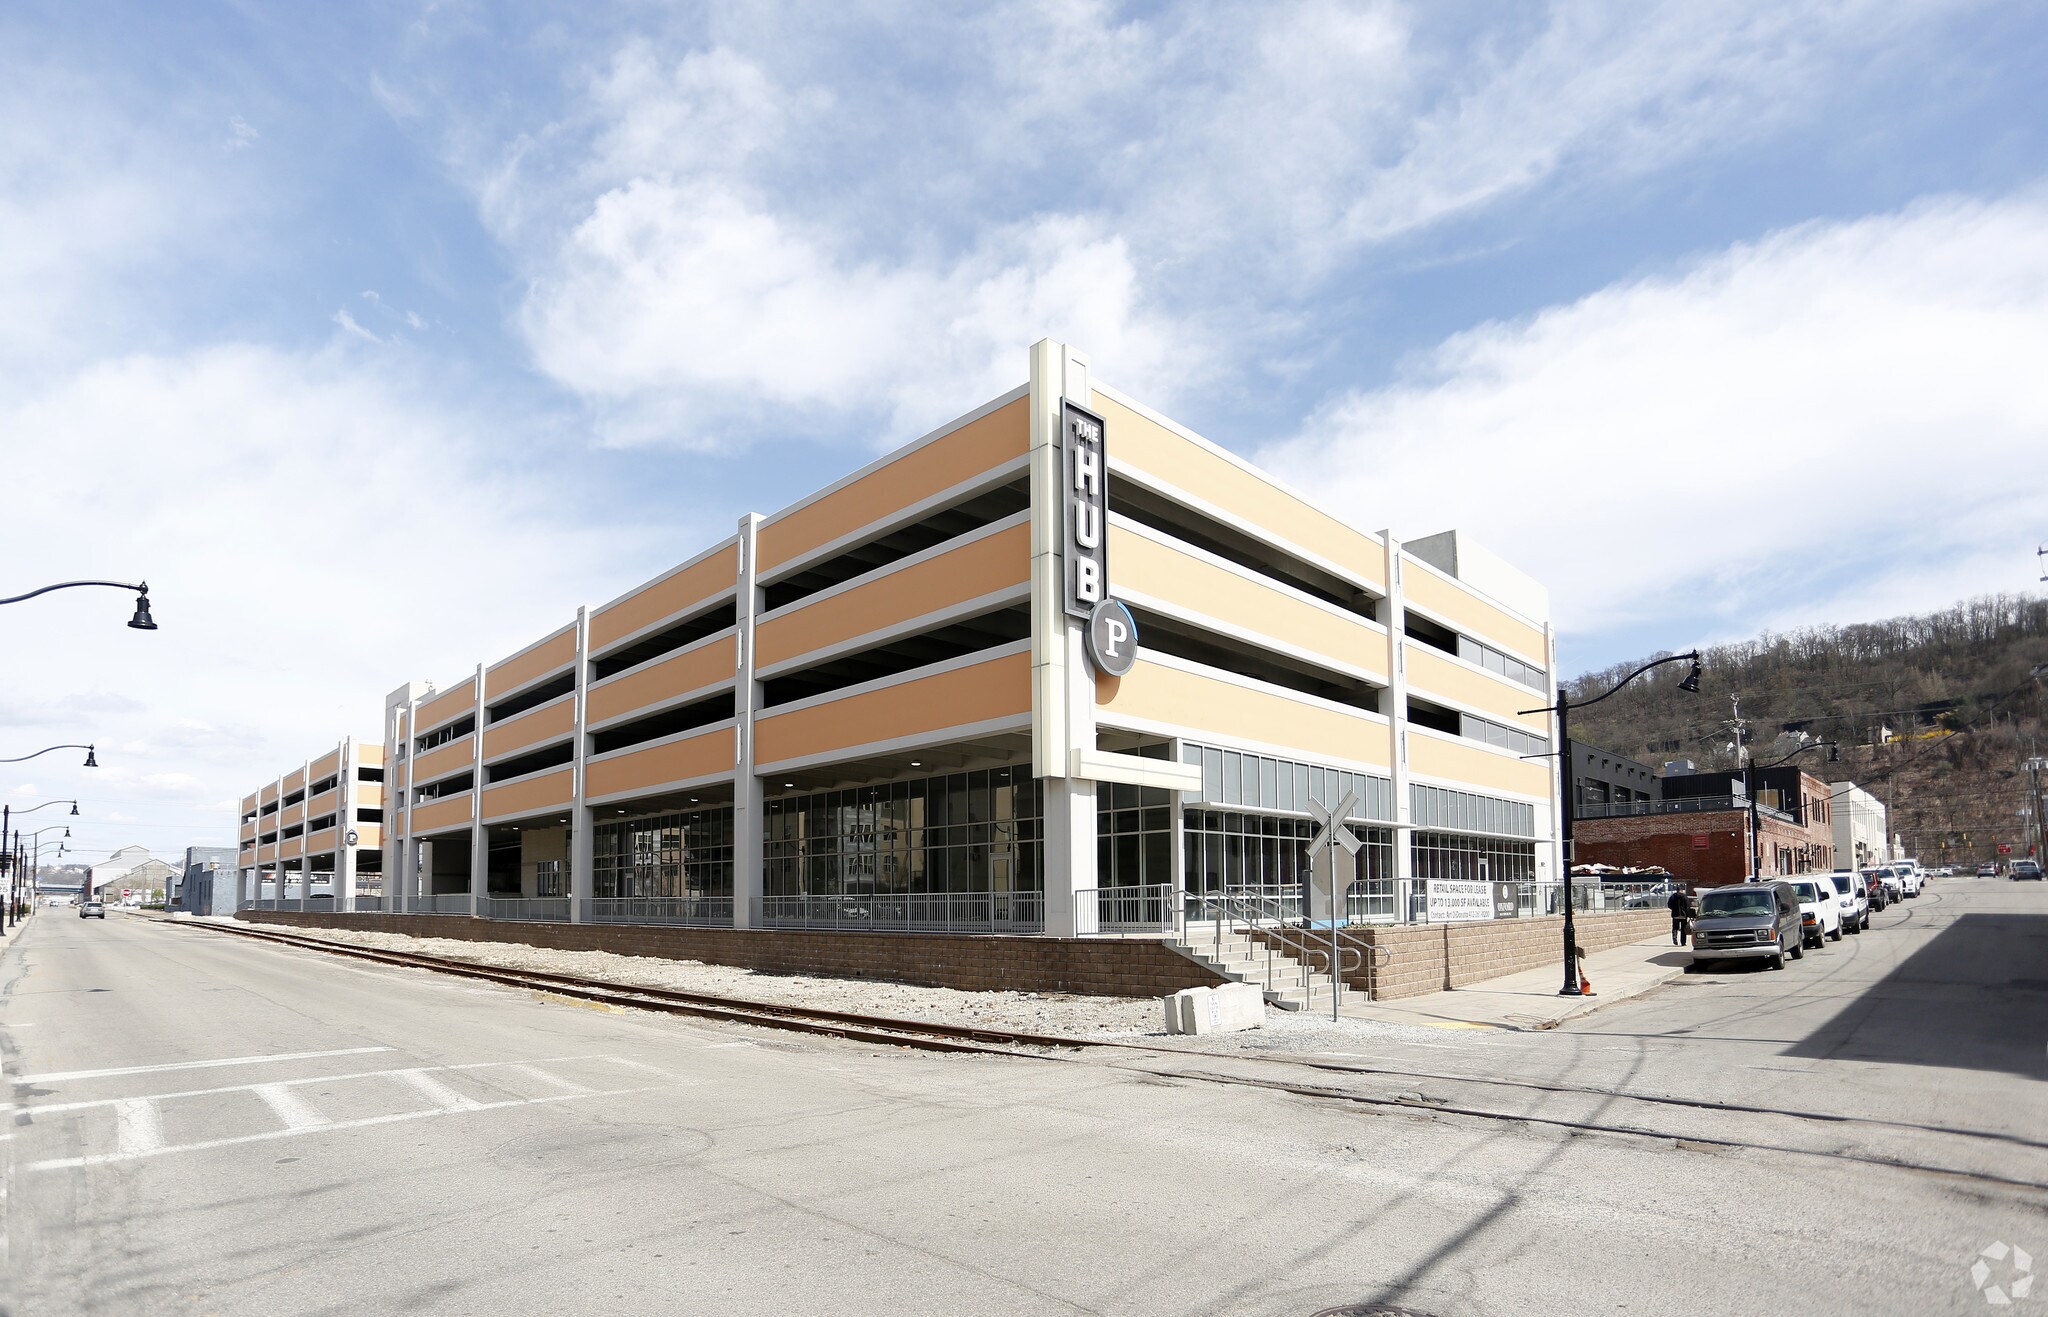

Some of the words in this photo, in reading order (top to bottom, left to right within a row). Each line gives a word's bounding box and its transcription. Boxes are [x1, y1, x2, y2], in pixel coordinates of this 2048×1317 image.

[1075, 418, 1099, 443] THE
[1075, 445, 1100, 603] HUB
[1104, 617, 1128, 658] P
[349, 834, 357, 842] P
[1433, 884, 1449, 893] RETAIL
[1450, 884, 1464, 894] SPACE
[1464, 885, 1473, 894] FOR
[1474, 885, 1487, 894] LEASE
[1430, 898, 1437, 907] UP
[1437, 898, 1444, 907] TO
[1460, 898, 1466, 907] SF
[1467, 898, 1490, 907] AVAILABLE
